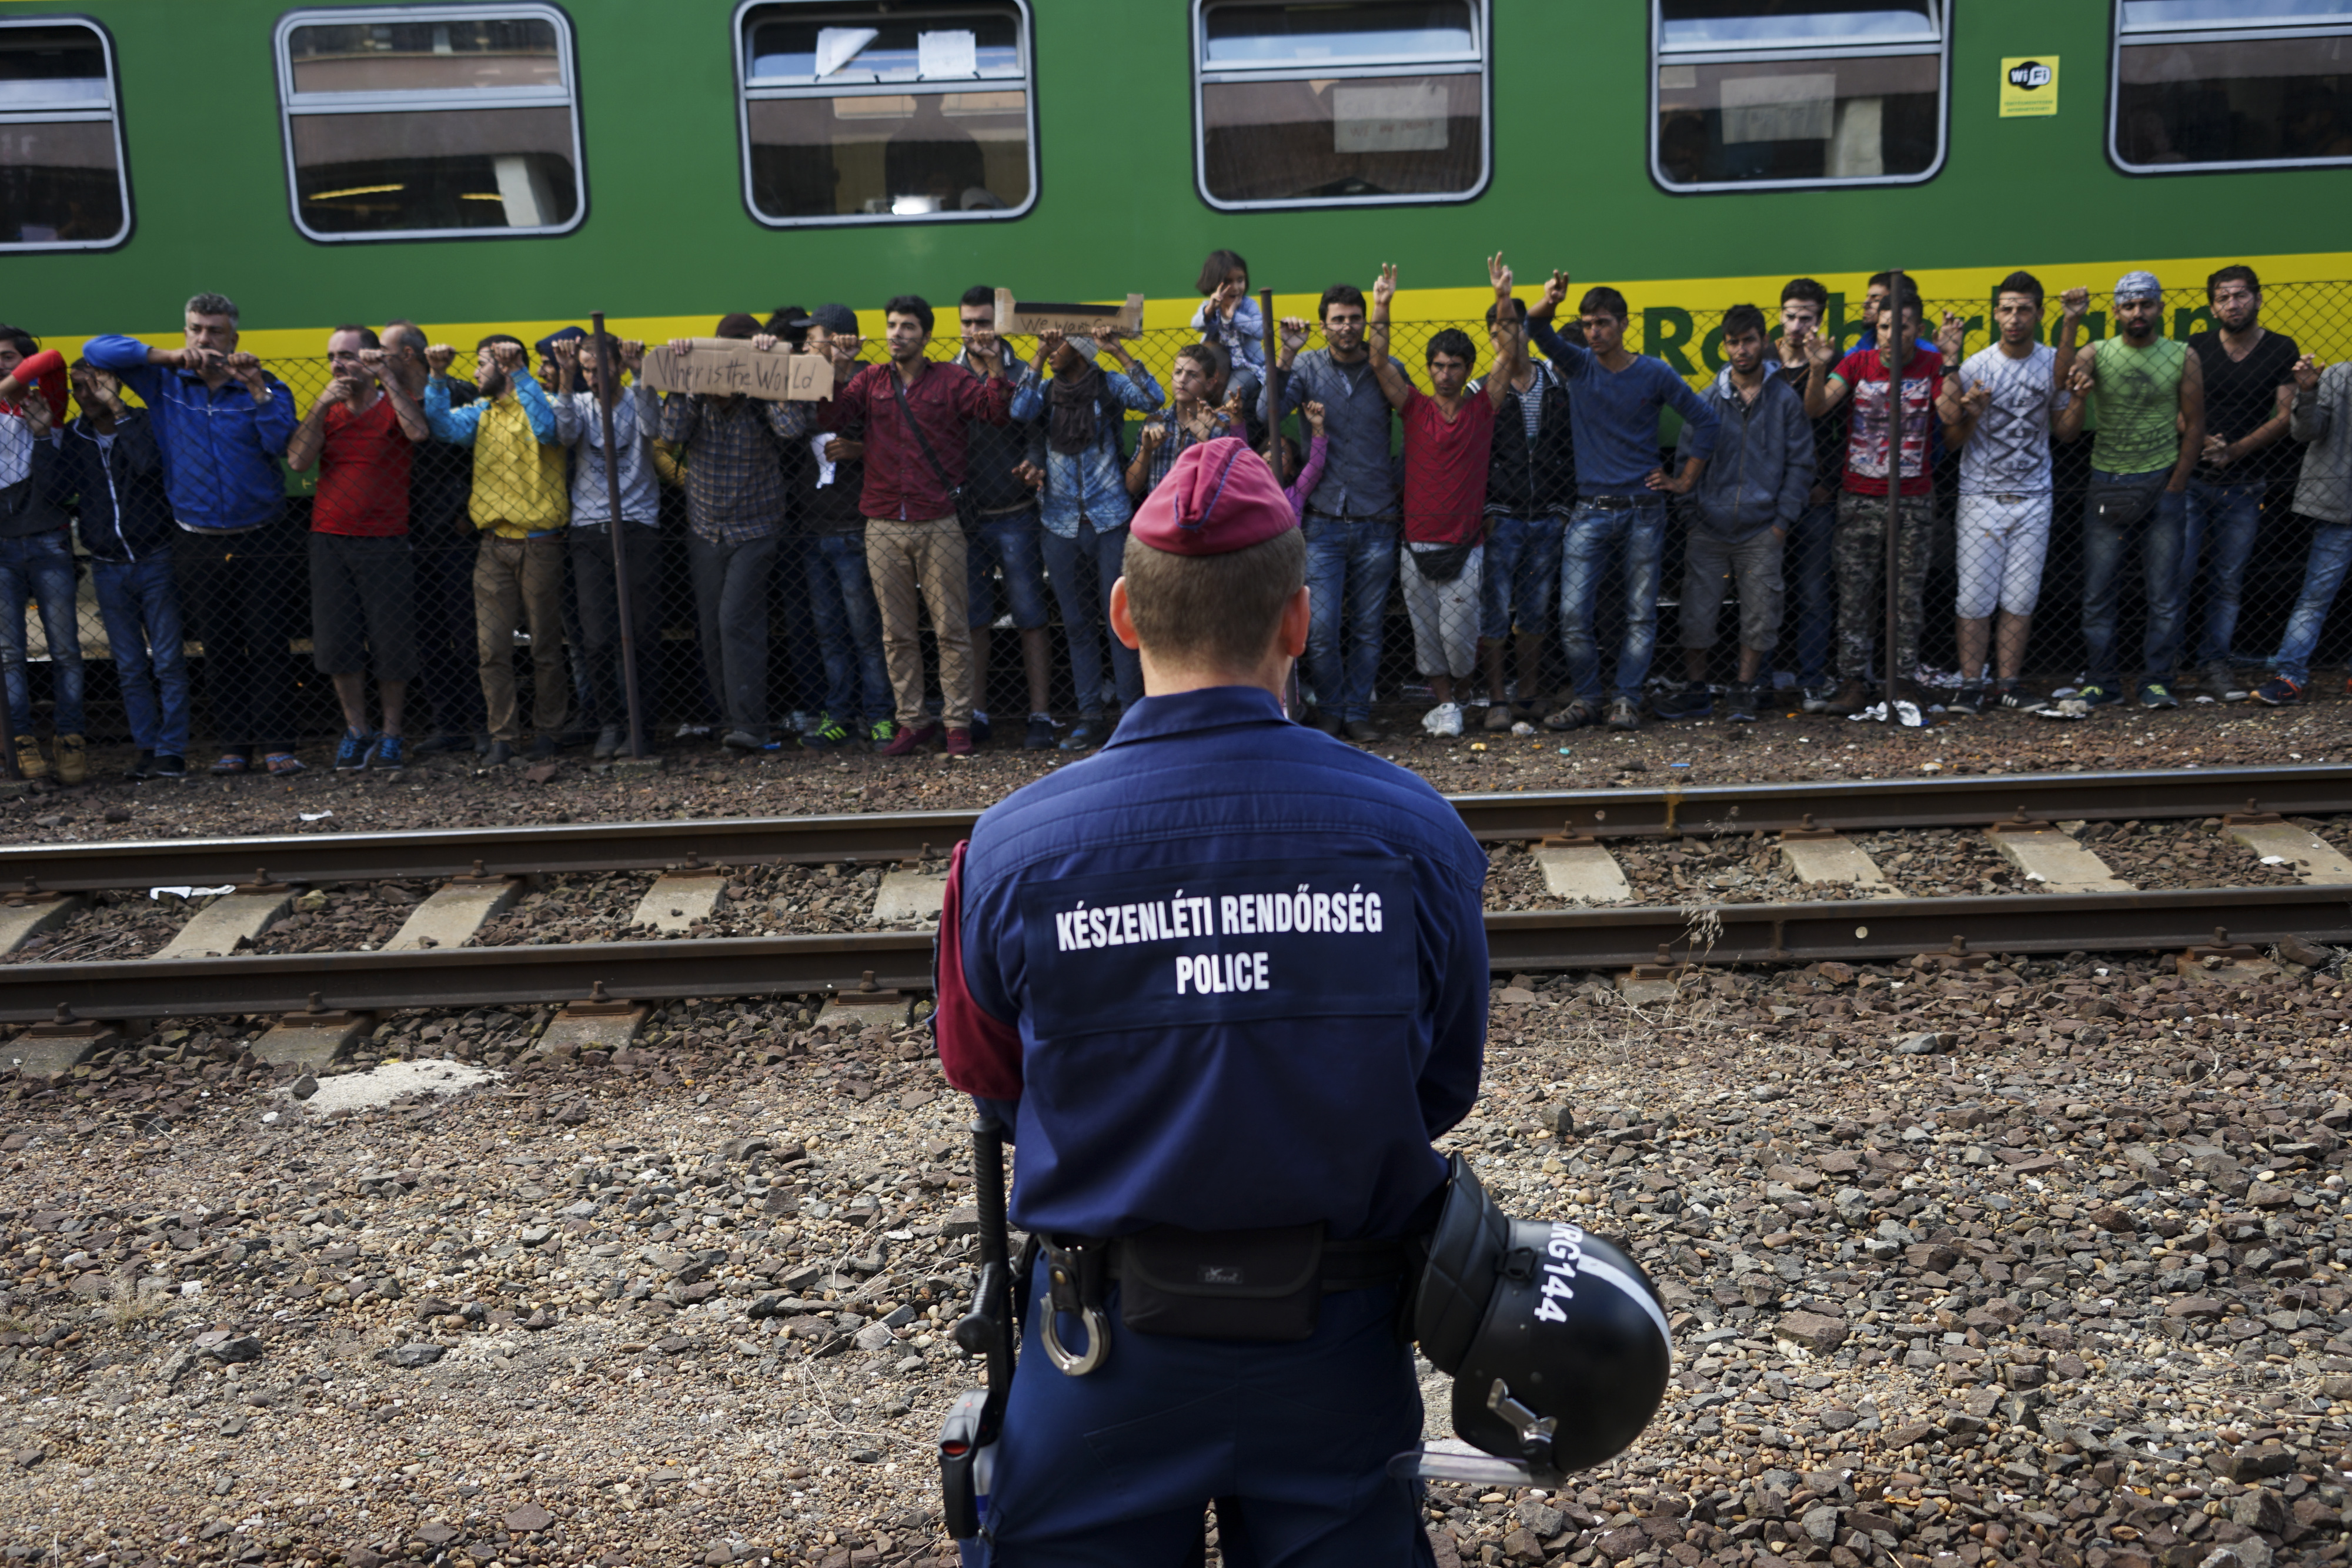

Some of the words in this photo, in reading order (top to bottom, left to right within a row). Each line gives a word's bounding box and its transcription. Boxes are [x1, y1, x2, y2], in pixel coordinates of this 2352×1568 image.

[1020, 316, 1048, 332] We
[706, 365, 723, 386] is
[724, 357, 752, 389] the
[1055, 888, 1214, 952] KÉSZENLÉTI
[1220, 883, 1383, 935] RENDŐRSÉG
[1176, 952, 1269, 995] POLICE
